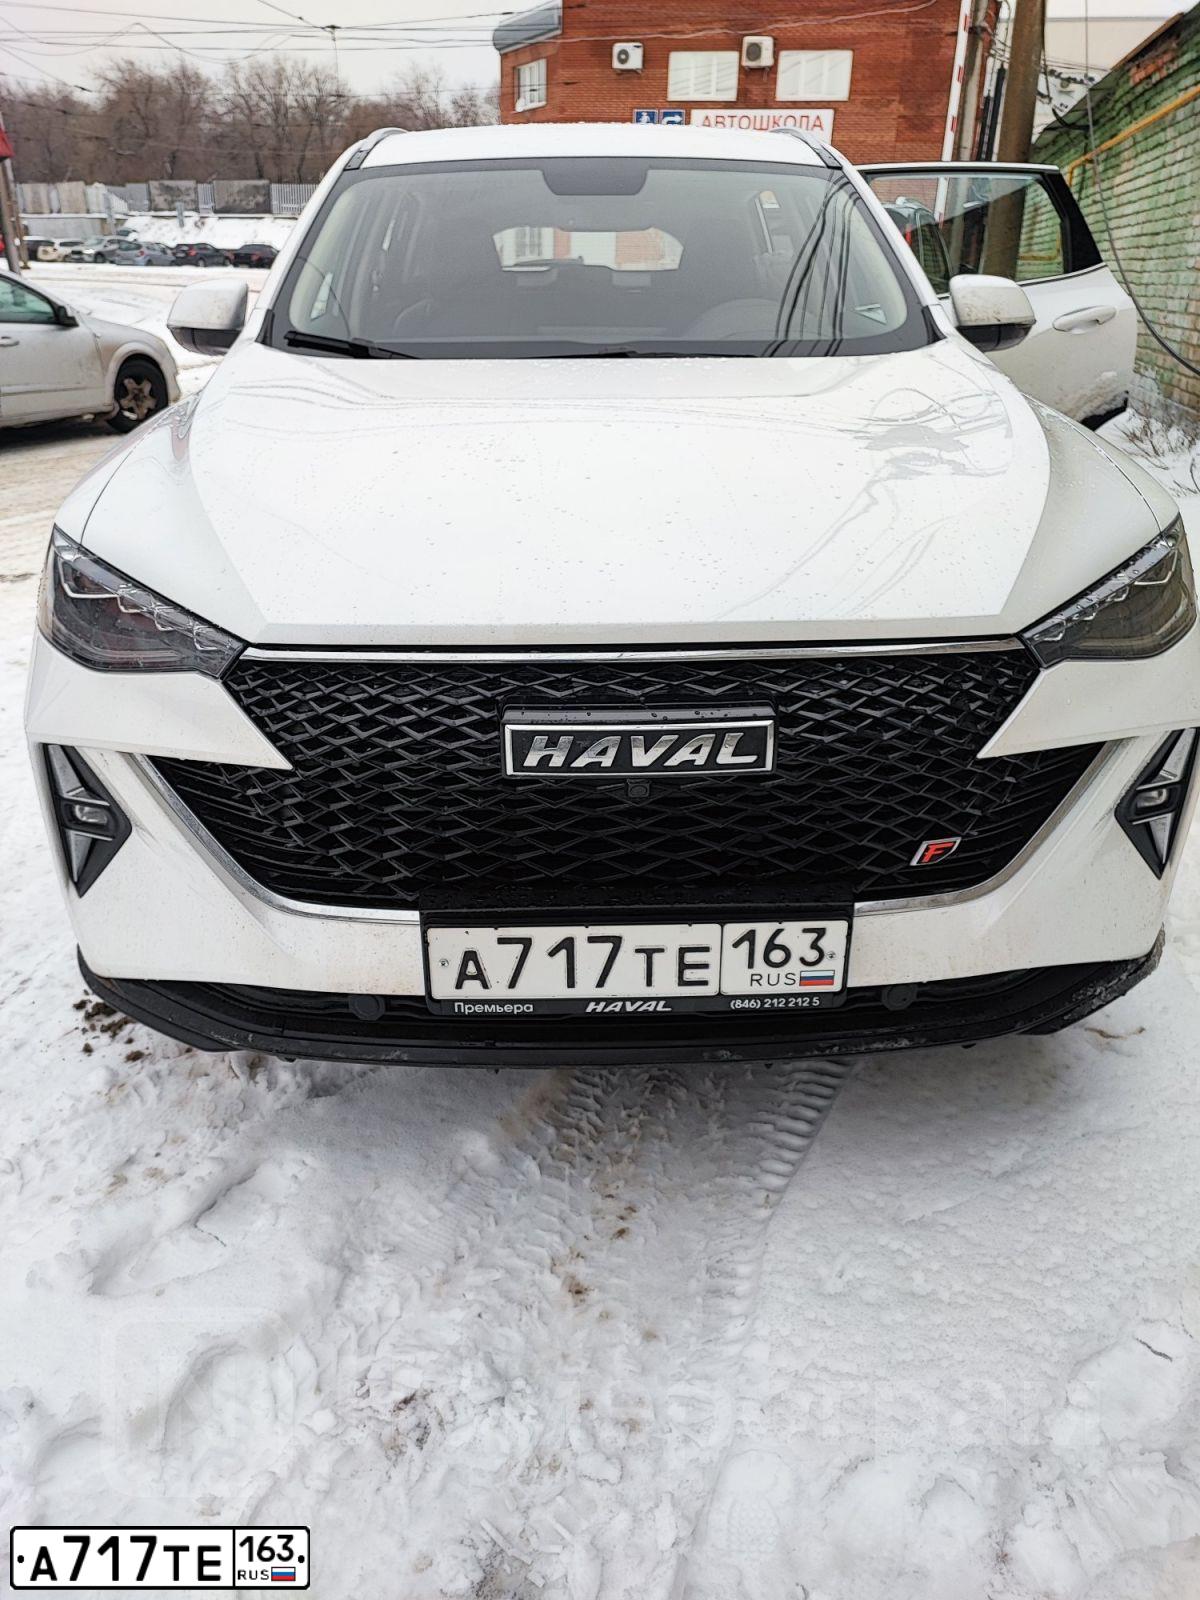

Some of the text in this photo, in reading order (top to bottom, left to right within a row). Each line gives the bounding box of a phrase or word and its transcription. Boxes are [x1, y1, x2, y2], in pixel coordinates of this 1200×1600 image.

[523, 733, 758, 767] HAVAL
[731, 927, 826, 969] 163
[750, 972, 797, 987] RUS
[454, 1002, 534, 1015] Премьера
[585, 1001, 672, 1013] HAVAL
[730, 999, 761, 1010] (846)
